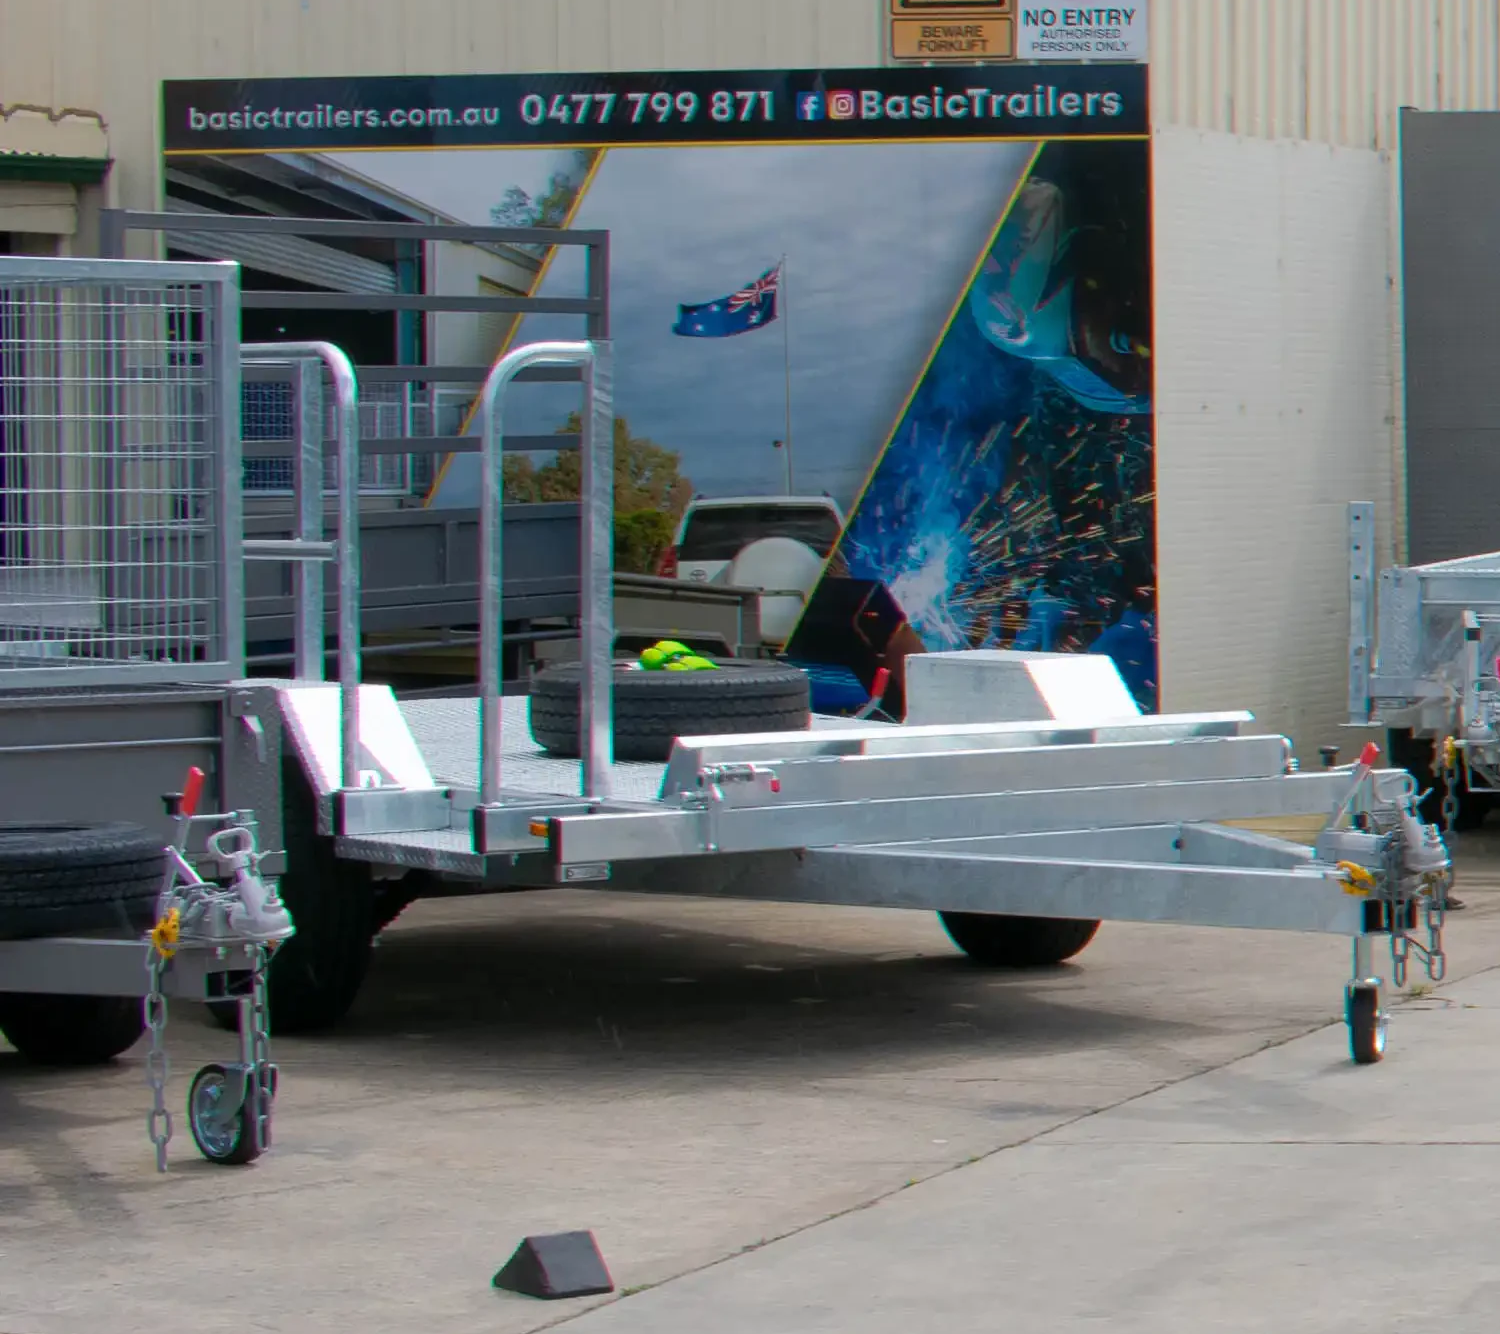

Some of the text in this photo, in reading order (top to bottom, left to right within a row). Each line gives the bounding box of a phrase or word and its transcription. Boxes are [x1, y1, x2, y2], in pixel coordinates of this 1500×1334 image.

[1024, 8, 1136, 27] NO ENTRY
[920, 25, 984, 39] BEWARE
[1040, 28, 1121, 40] AUTHORISED
[917, 38, 989, 53] FORKLIFT
[1032, 40, 1129, 53] PERSONS ONLY
[188, 104, 500, 131] basictrailers.com.au
[520, 92, 617, 125] 0477
[626, 90, 699, 123] 799
[710, 89, 775, 122] 871
[859, 84, 1124, 119] BasicTrailers
